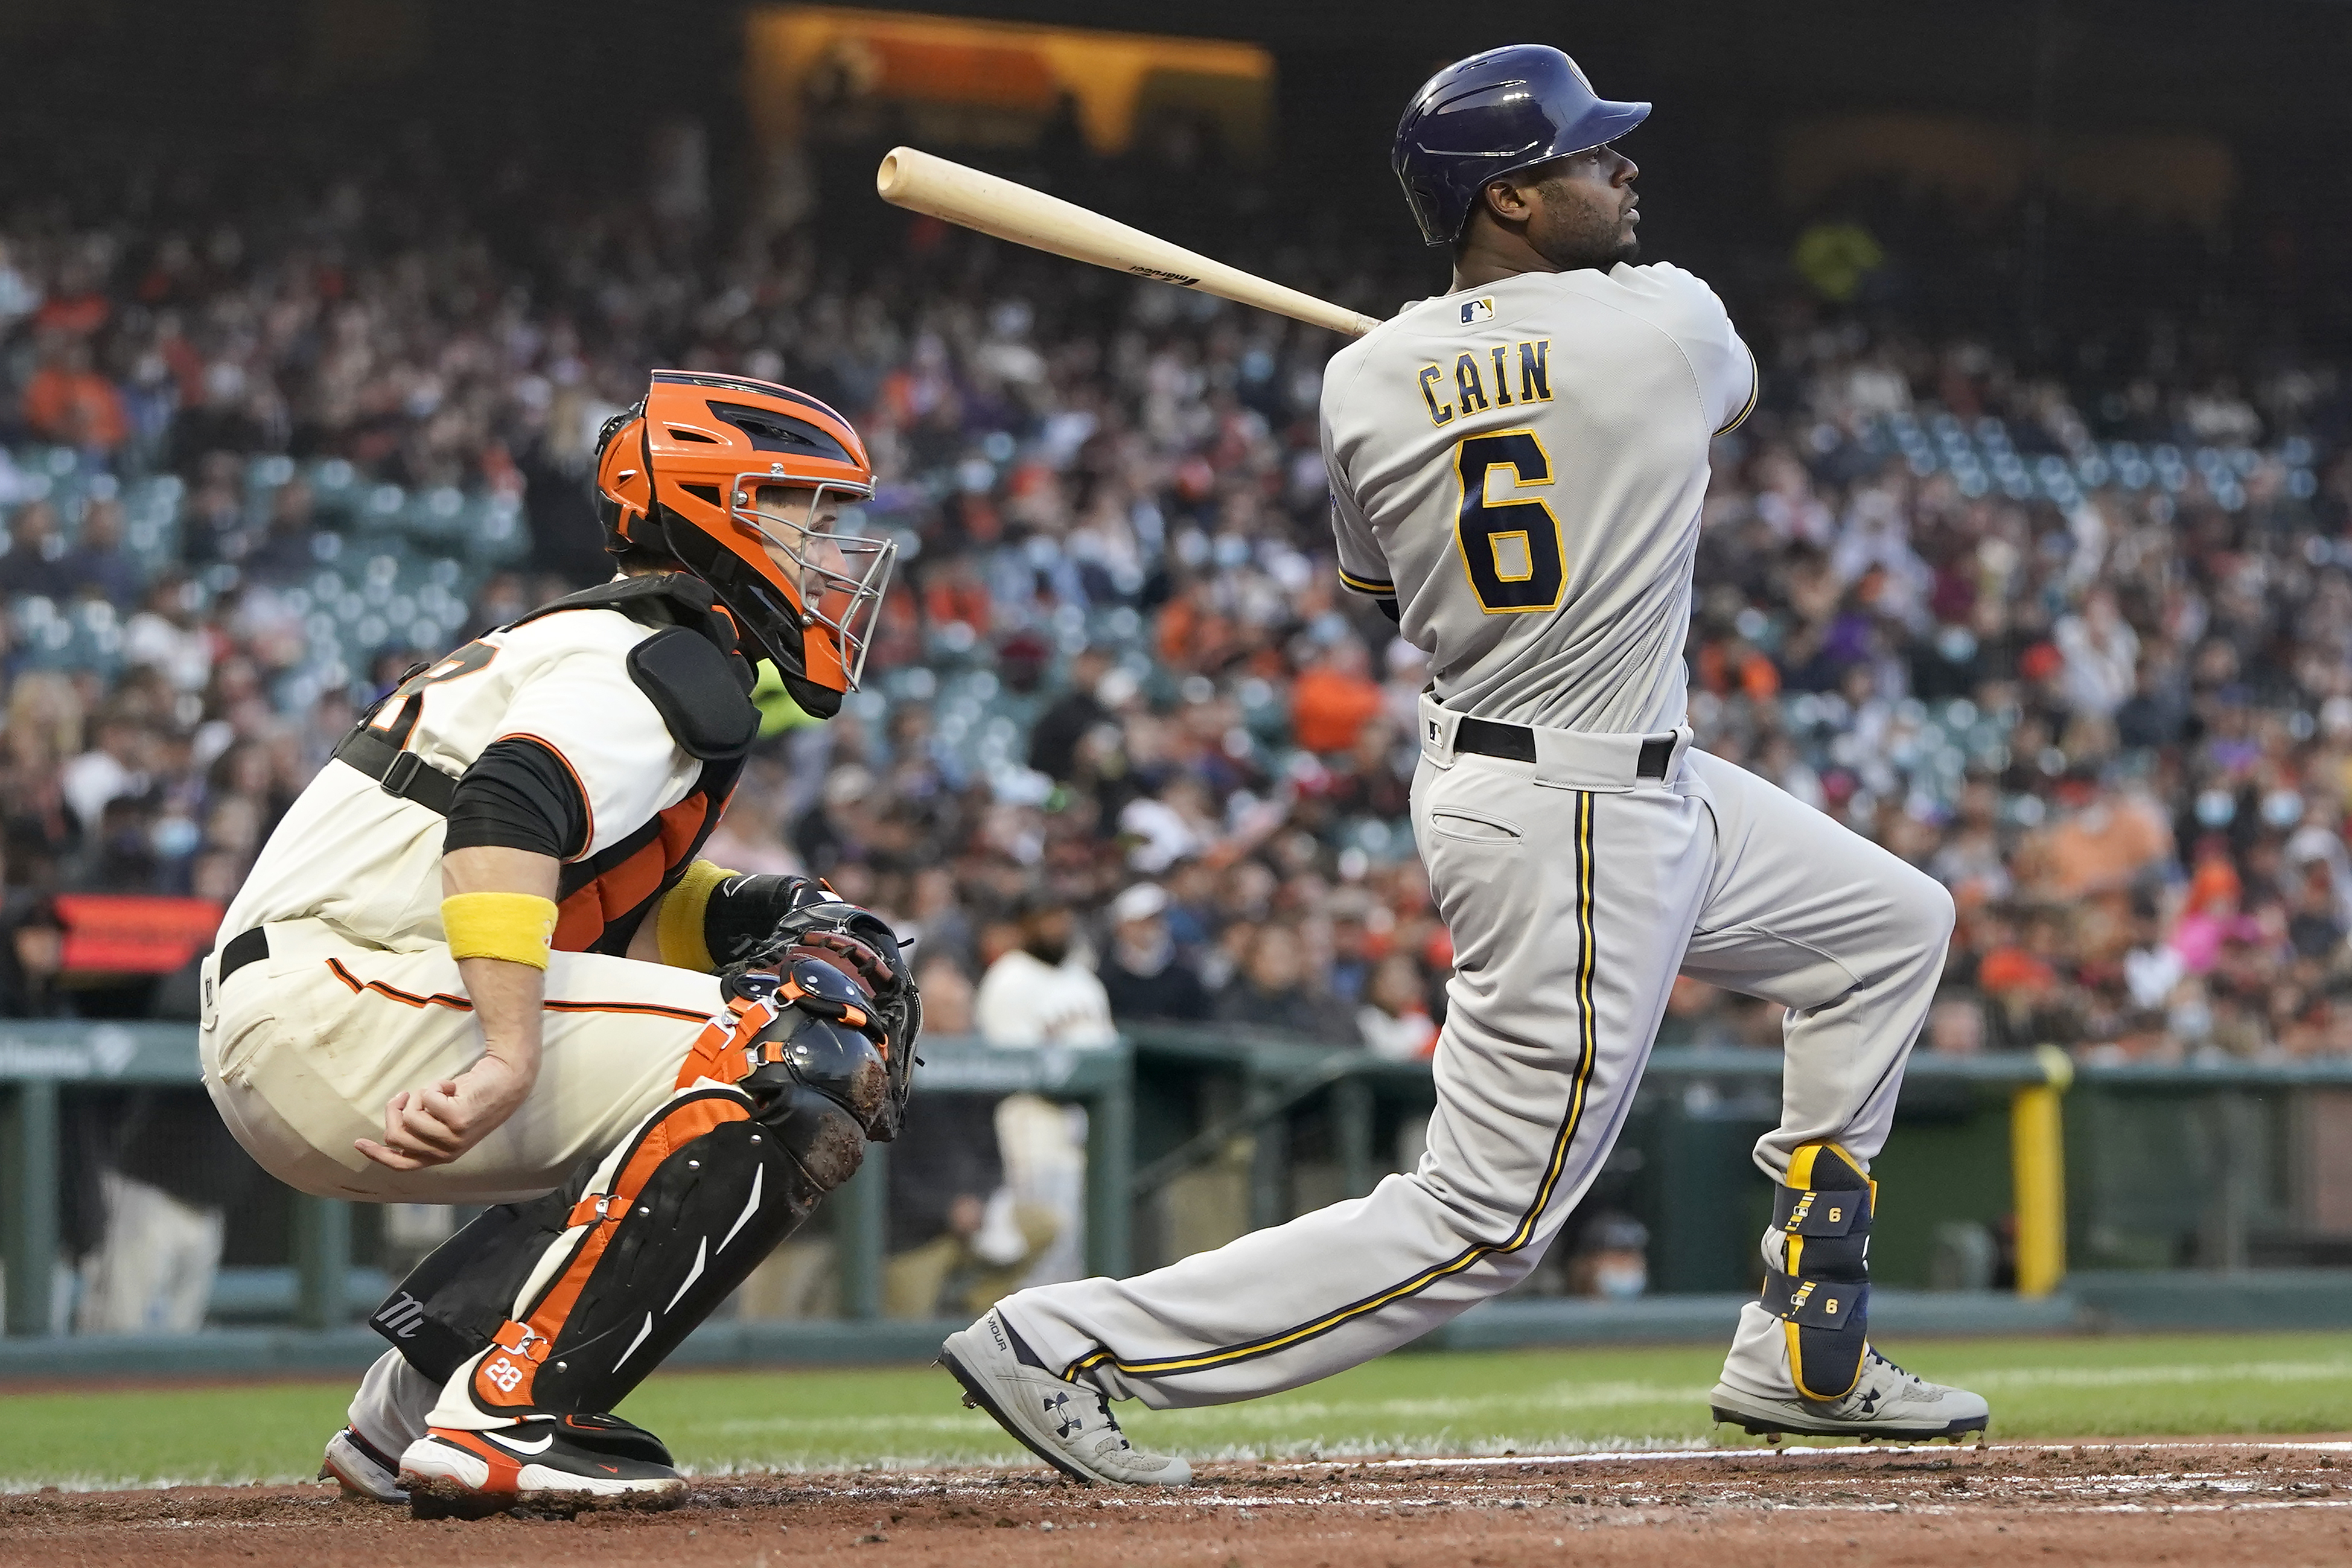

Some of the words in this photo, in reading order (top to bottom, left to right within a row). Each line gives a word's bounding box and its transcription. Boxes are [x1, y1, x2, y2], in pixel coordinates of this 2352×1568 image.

[1417, 338, 1554, 428] CAIN
[1453, 427, 1568, 614] 6
[1829, 1207, 1842, 1223] 6
[1825, 1298, 1839, 1315] 6
[986, 1313, 1007, 1352] MOUR
[484, 1357, 523, 1392] 28
